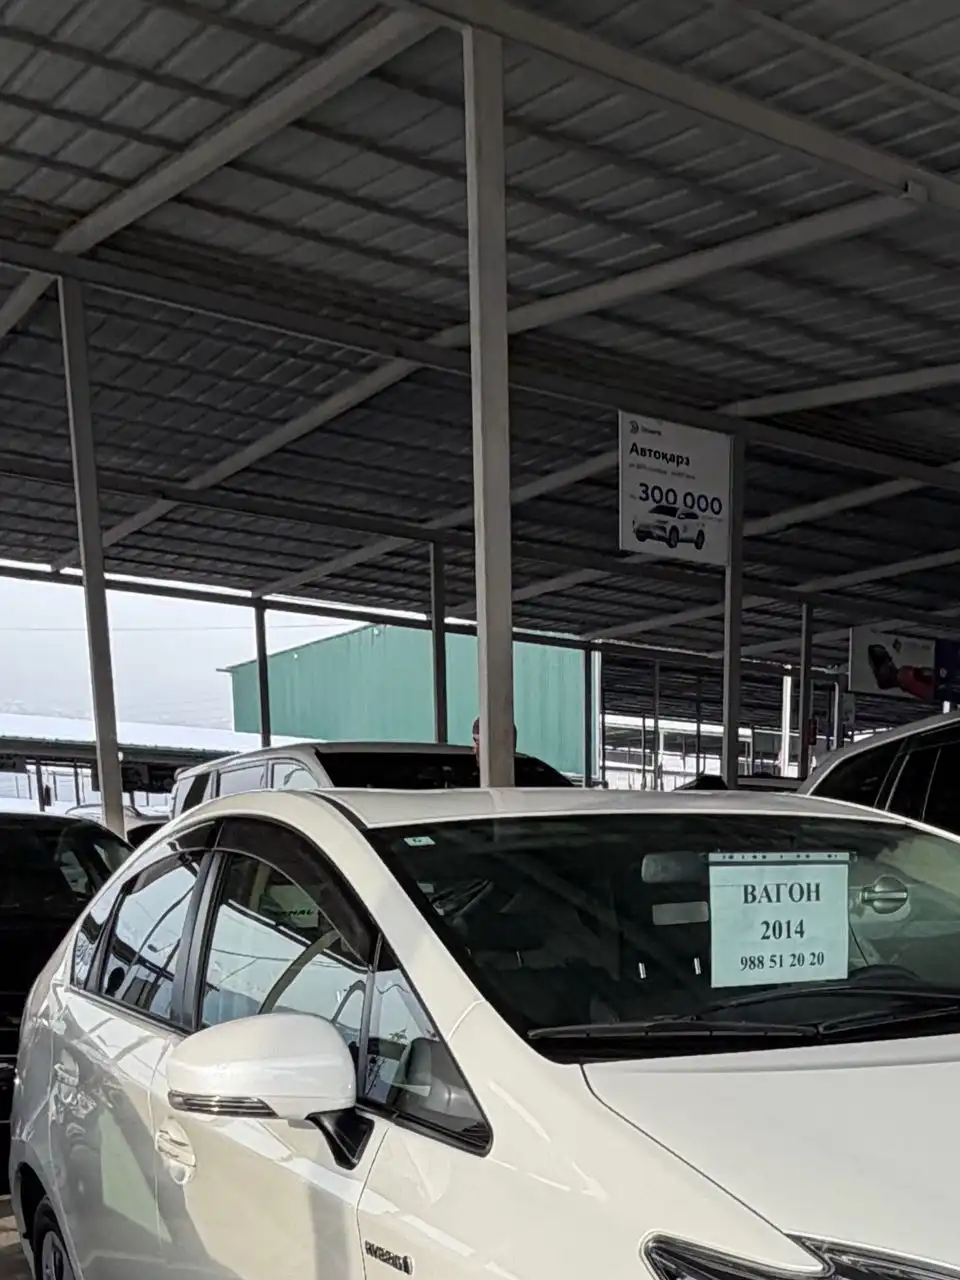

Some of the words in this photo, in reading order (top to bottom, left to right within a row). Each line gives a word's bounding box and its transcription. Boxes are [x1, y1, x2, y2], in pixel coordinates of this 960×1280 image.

[638, 482, 678, 505] 300
[683, 492, 722, 515] 000
[743, 882, 821, 904] ВАГОН
[761, 919, 805, 940] 2014
[740, 956, 765, 971] 988
[769, 954, 784, 969] 51
[789, 953, 805, 967] 20
[809, 952, 825, 966] 20
